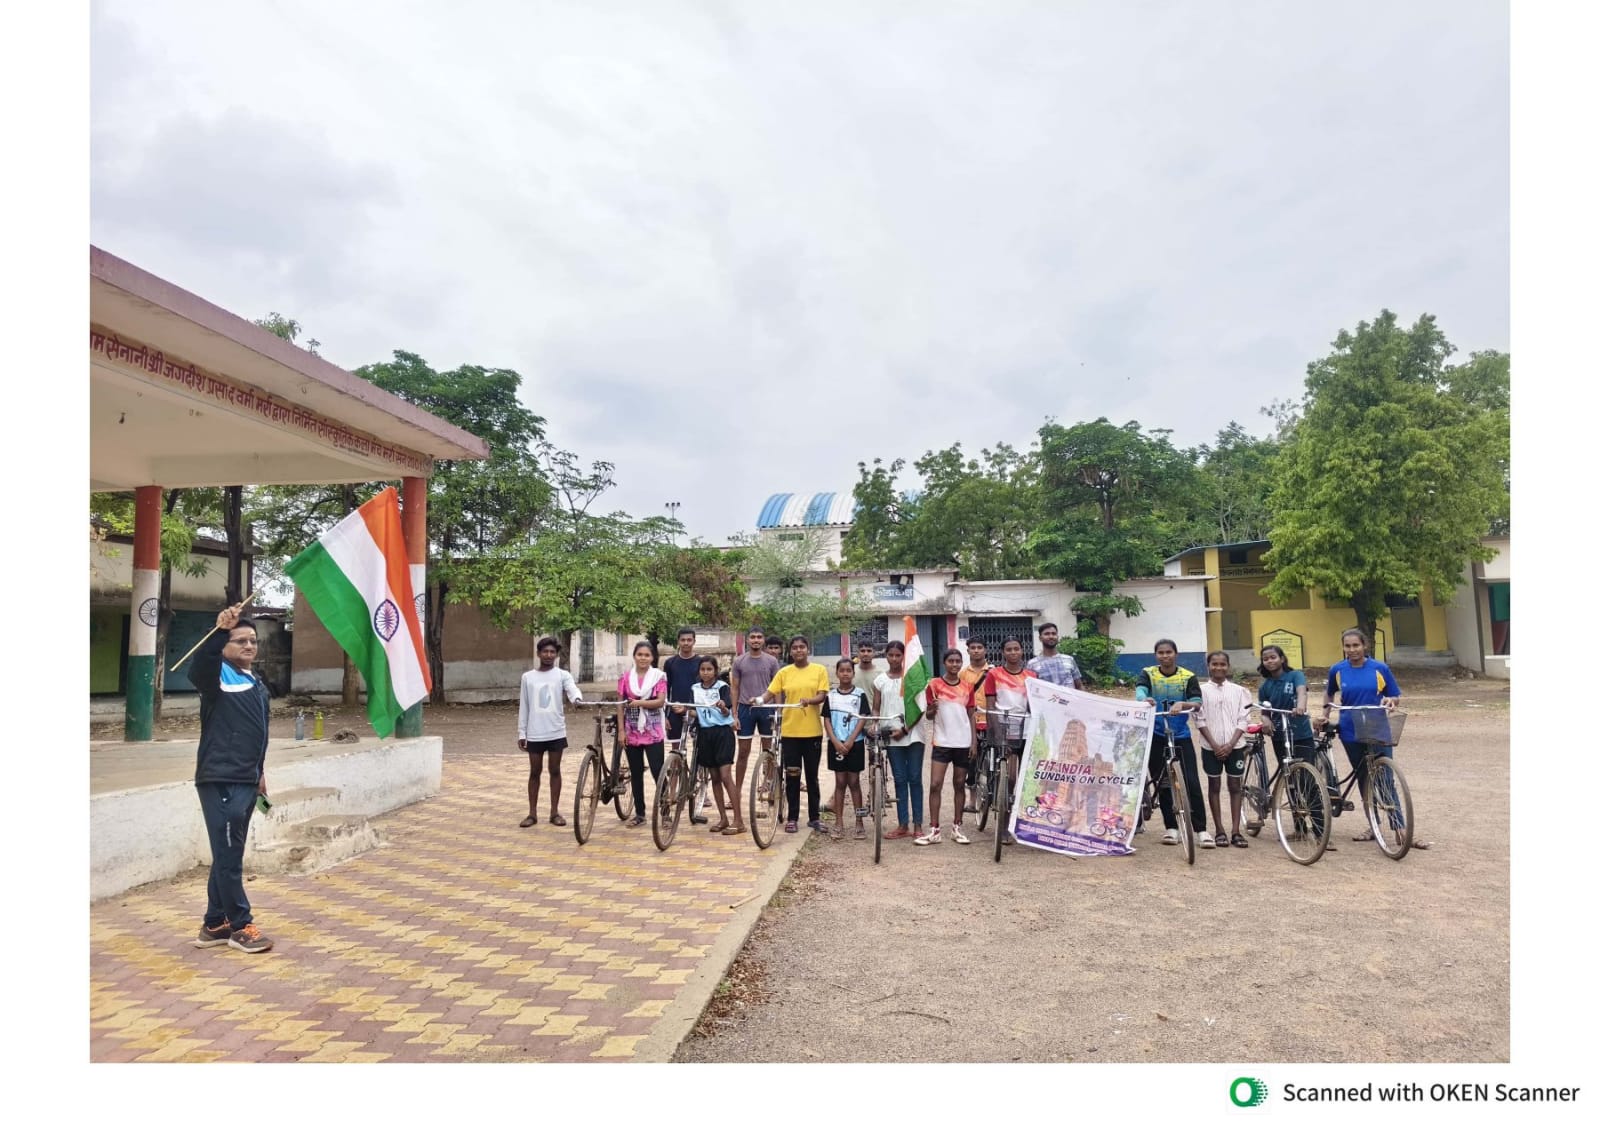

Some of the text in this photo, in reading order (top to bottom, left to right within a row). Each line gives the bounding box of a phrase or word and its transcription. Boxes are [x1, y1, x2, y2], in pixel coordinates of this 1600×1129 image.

[107, 334, 147, 369] सेनानी
[163, 361, 207, 392] जगदीश
[207, 377, 234, 405] प्रसाद
[703, 709, 712, 719] 11
[1036, 760, 1092, 775] FIT INDIA
[1033, 771, 1134, 785] SUNDAYS ON CYCLE
